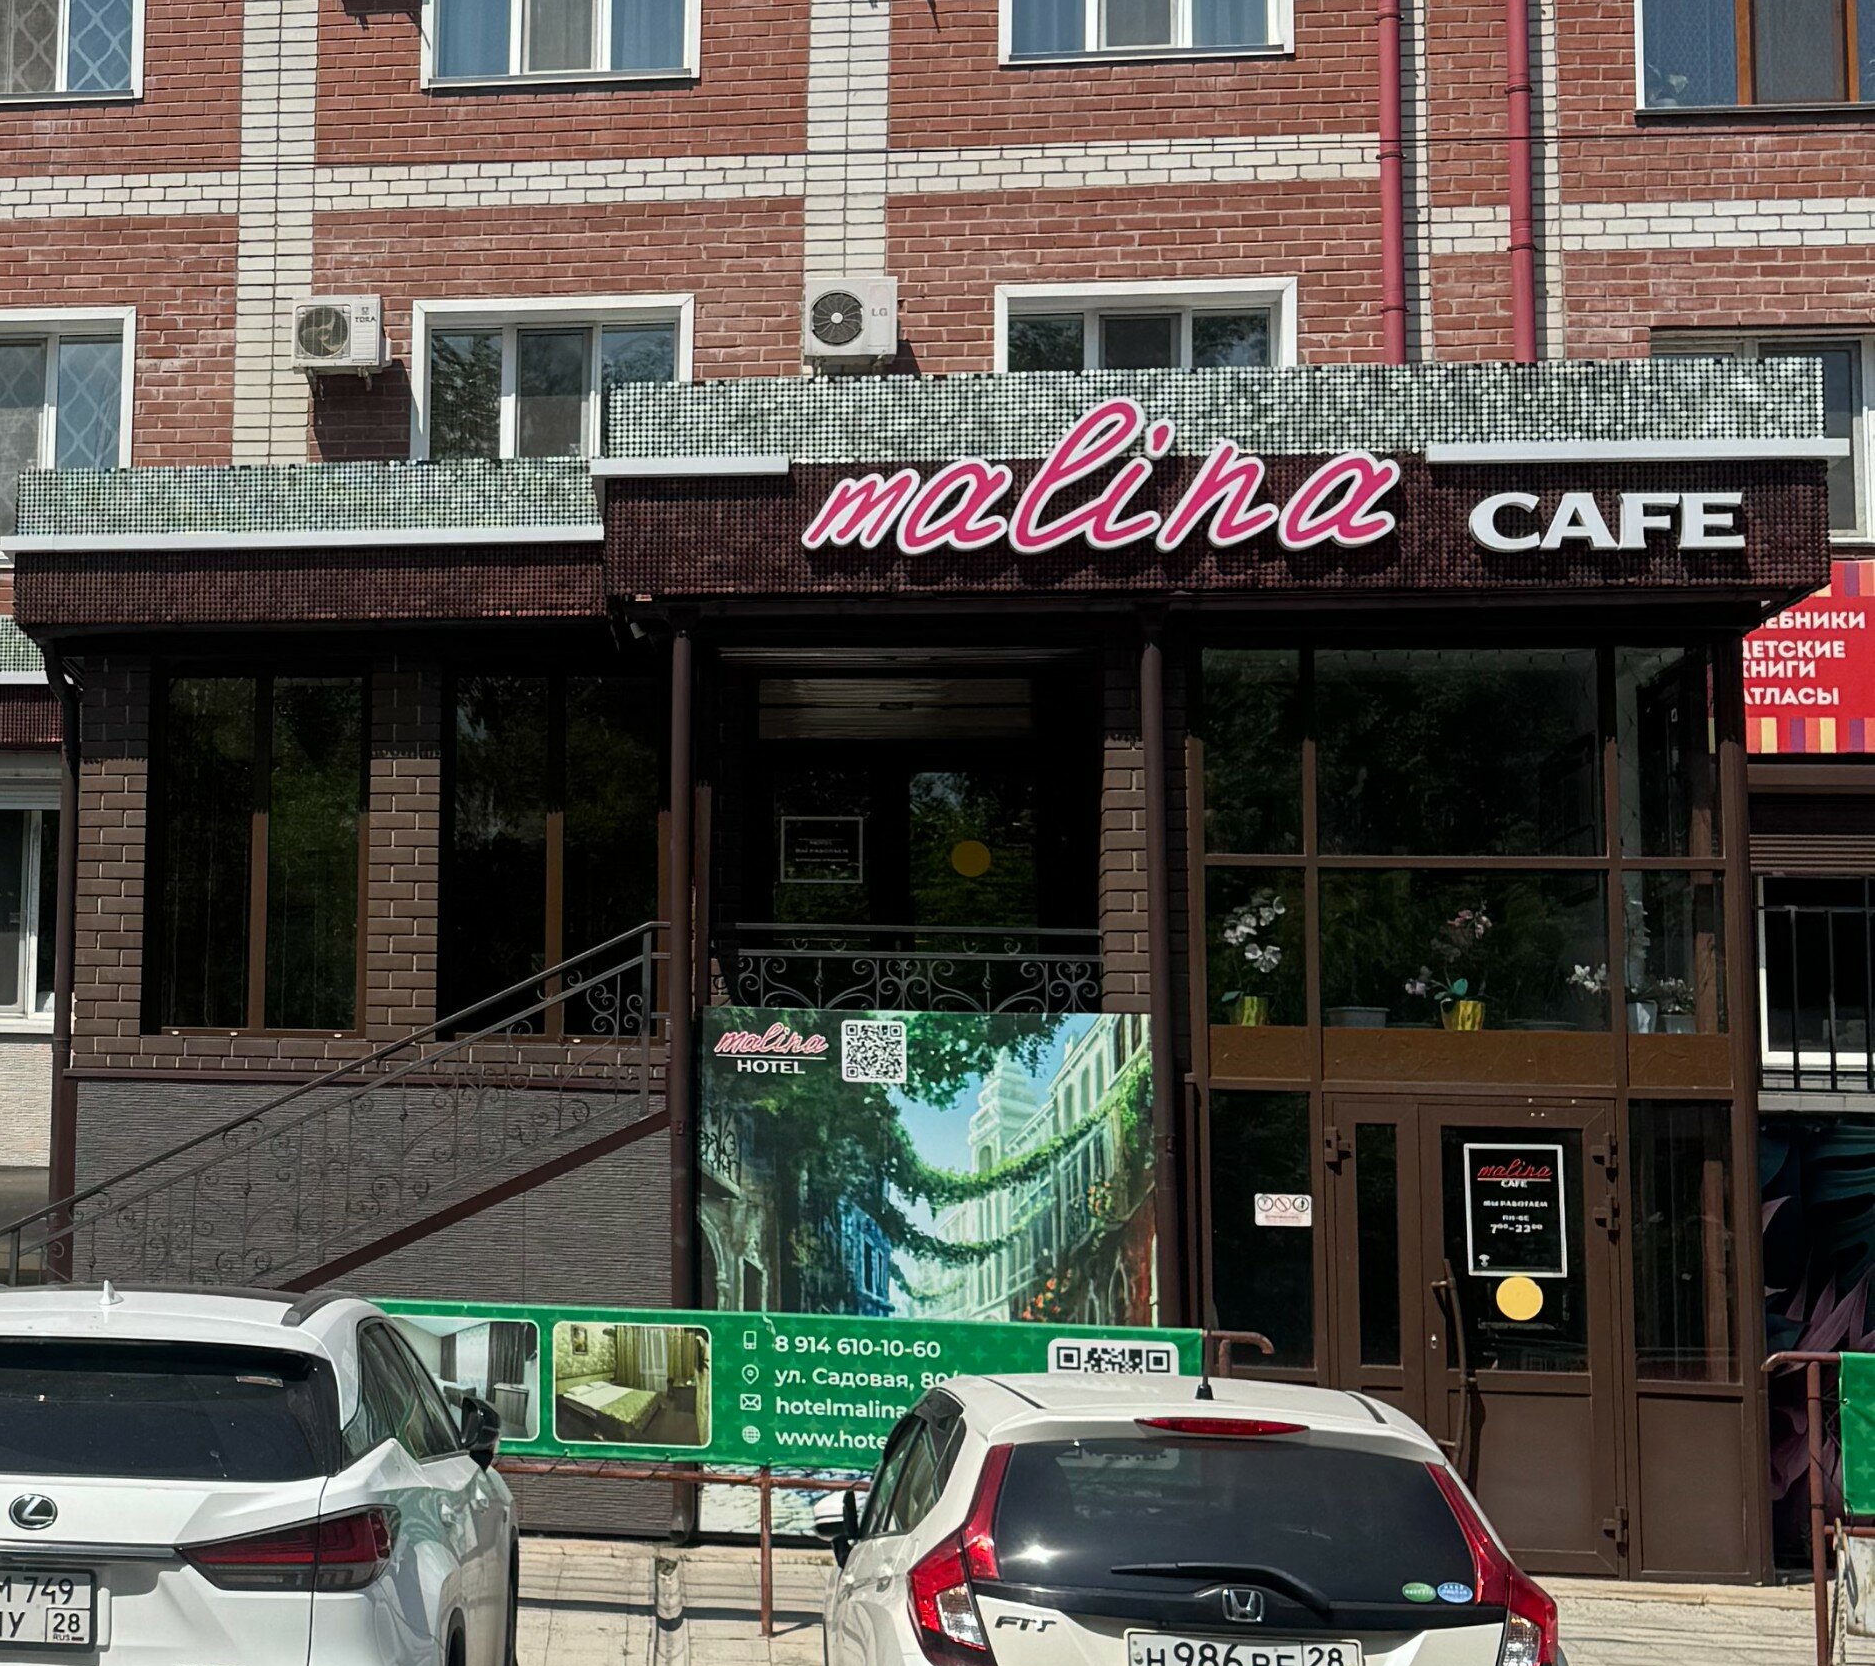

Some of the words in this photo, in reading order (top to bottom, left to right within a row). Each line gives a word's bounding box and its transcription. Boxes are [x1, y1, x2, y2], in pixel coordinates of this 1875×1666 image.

[871, 307, 888, 317] LG
[801, 397, 1400, 556] malina
[1469, 491, 1747, 553] CAFE
[1761, 611, 1866, 629] ЕБНИКИ
[714, 1021, 830, 1055] malina
[736, 1059, 806, 1075] HOTEL
[1477, 1158, 1553, 1178] malina
[774, 1335, 790, 1353] 8
[794, 1336, 832, 1354] 914
[836, 1337, 942, 1358] 610-10-60
[774, 1369, 807, 1387] ул.
[812, 1367, 915, 1391] Садовая,
[775, 1396, 908, 1420] hotelmalina
[775, 1429, 888, 1450] www.hote
[52, 1612, 81, 1634] 28
[52, 1633, 71, 1641] RUS
